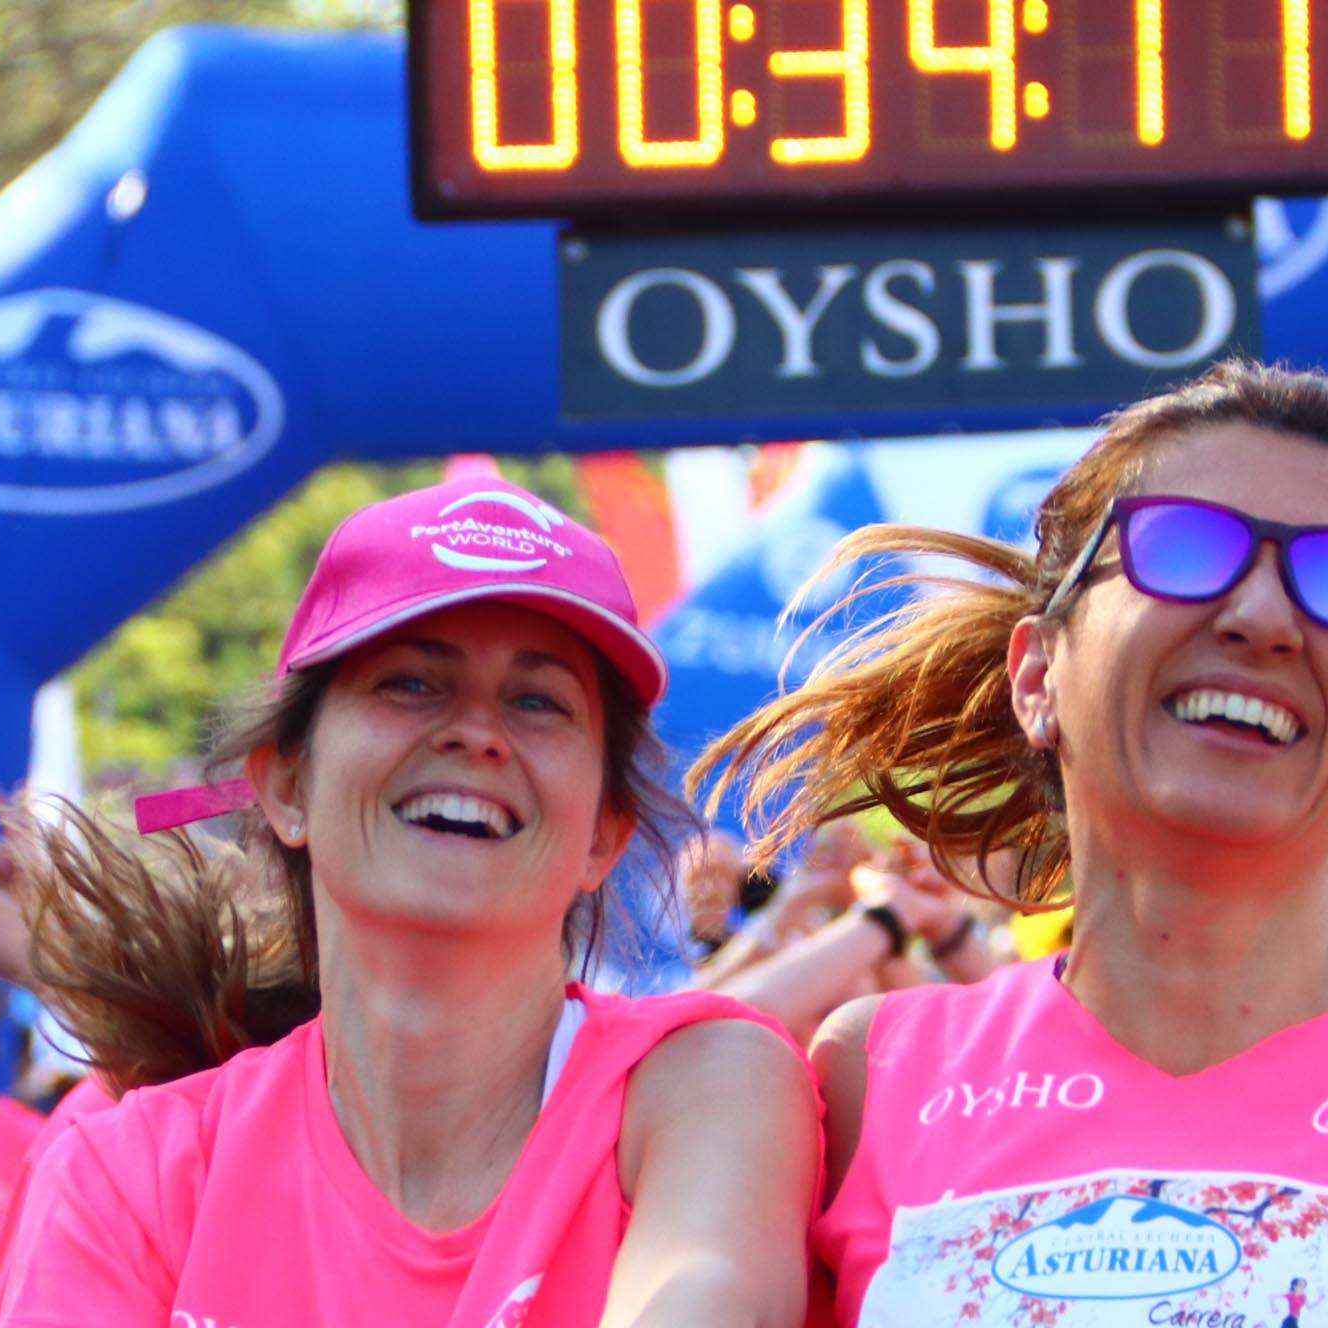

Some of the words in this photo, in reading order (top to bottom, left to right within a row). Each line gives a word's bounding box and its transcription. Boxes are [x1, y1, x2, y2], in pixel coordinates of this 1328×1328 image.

[595, 247, 1238, 388] OYSHO
[448, 532, 536, 555] WORLD
[919, 1071, 1105, 1126] OYSHO
[1008, 1243, 1221, 1279] ASTURIANA
